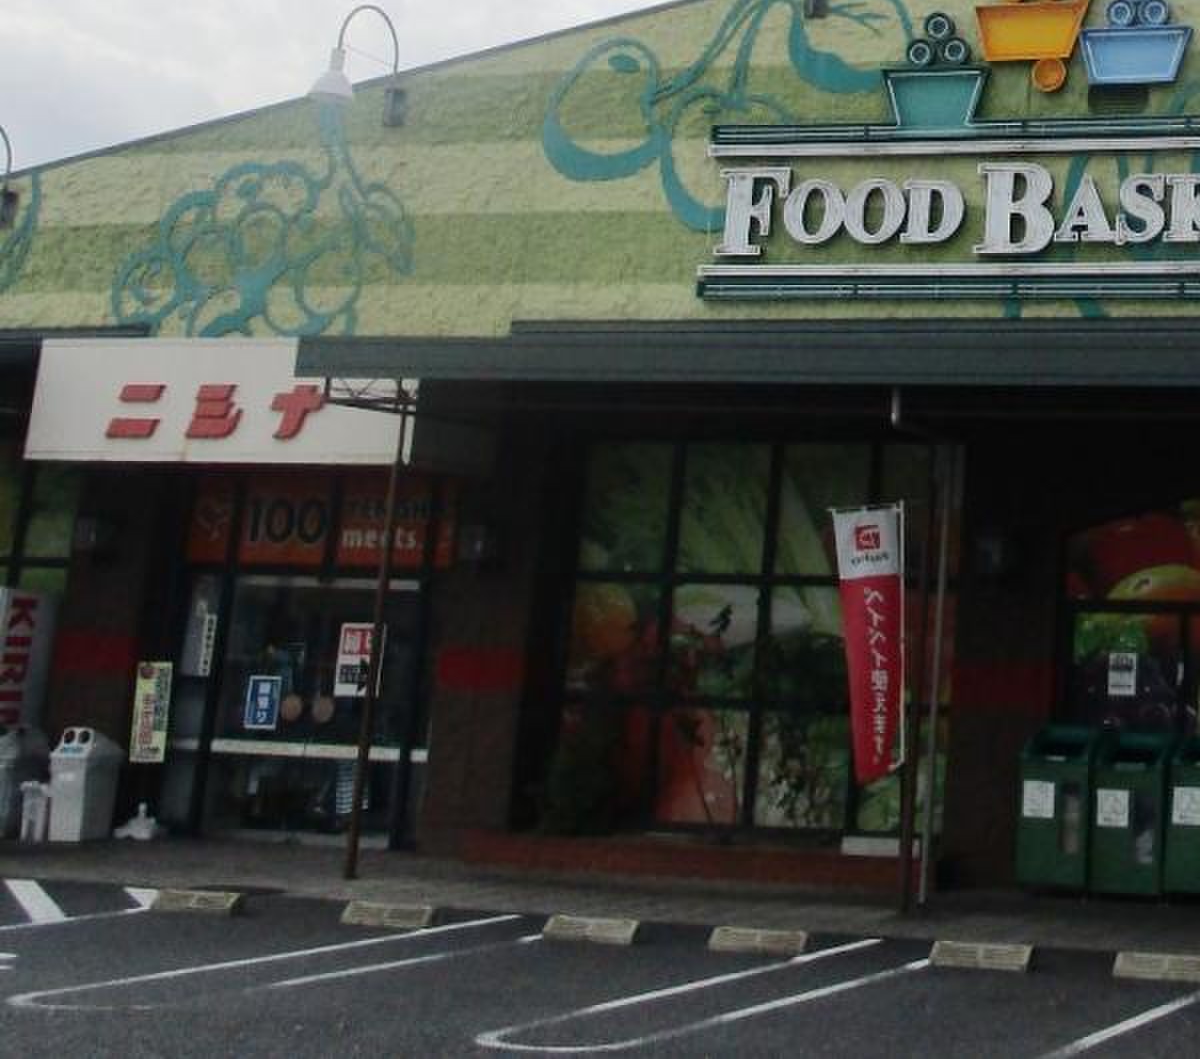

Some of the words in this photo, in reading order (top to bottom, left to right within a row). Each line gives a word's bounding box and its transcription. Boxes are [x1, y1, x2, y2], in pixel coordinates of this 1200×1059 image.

[712, 162, 965, 256] FOOD
[105, 383, 328, 440] ニシナ
[250, 498, 327, 544] 100
